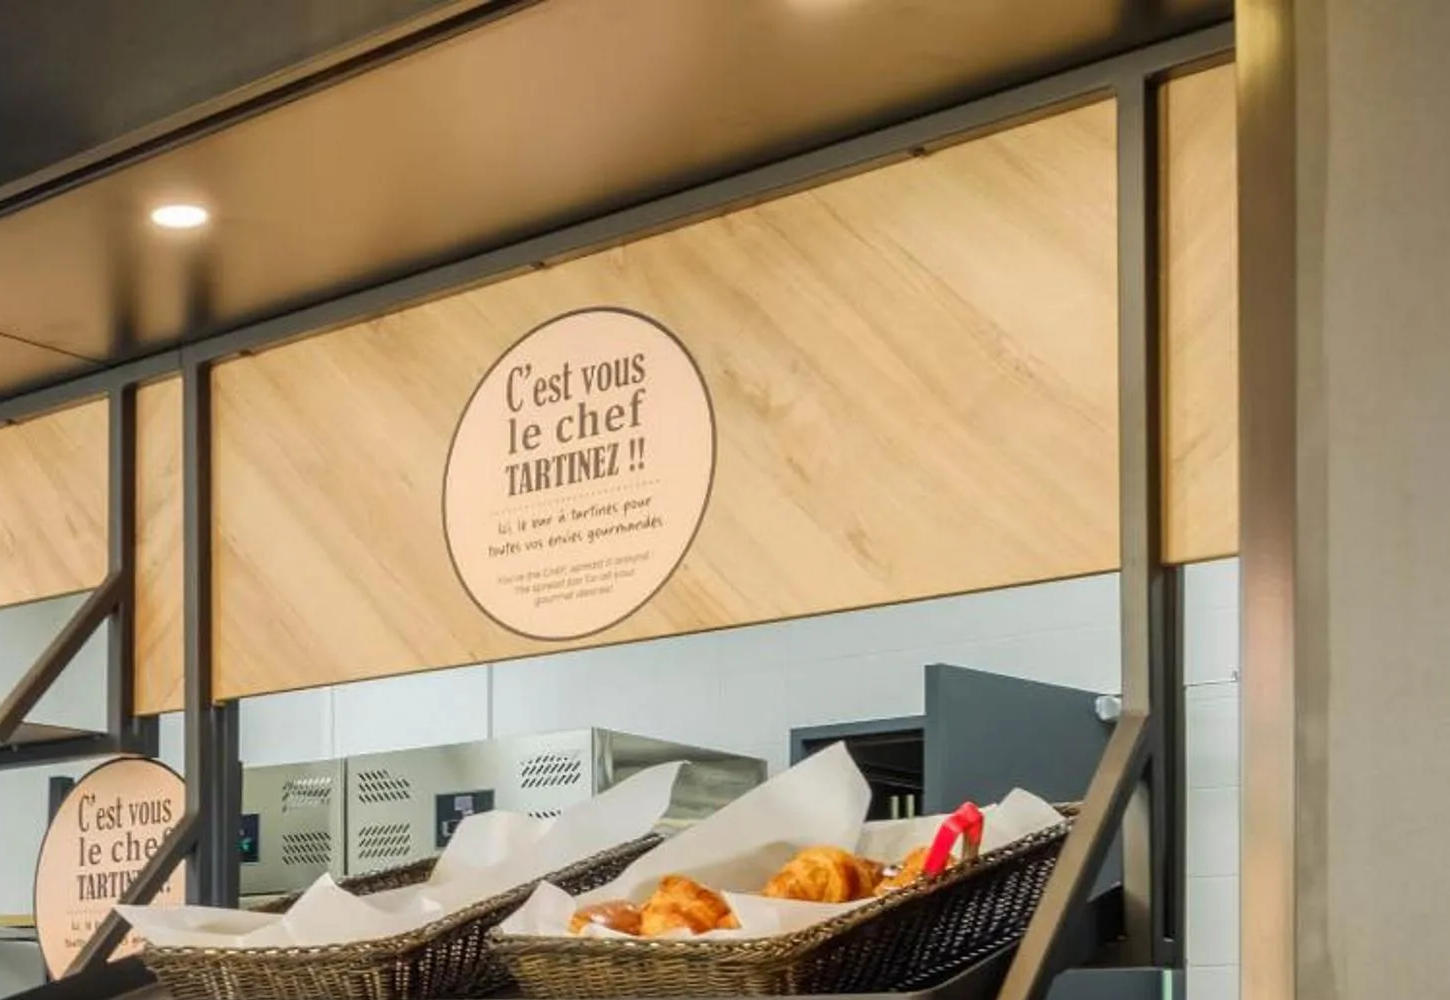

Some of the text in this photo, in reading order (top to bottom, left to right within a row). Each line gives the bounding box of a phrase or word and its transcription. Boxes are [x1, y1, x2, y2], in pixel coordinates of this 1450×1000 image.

[581, 352, 646, 396] vous
[508, 387, 646, 456] le chef
[505, 436, 645, 497] TARTINEZ !!
[571, 503, 619, 521] tartines
[624, 495, 653, 517] pour
[488, 513, 664, 557] toutes vos envies gourmandes
[129, 798, 172, 826] vous
[78, 837, 102, 867] le
